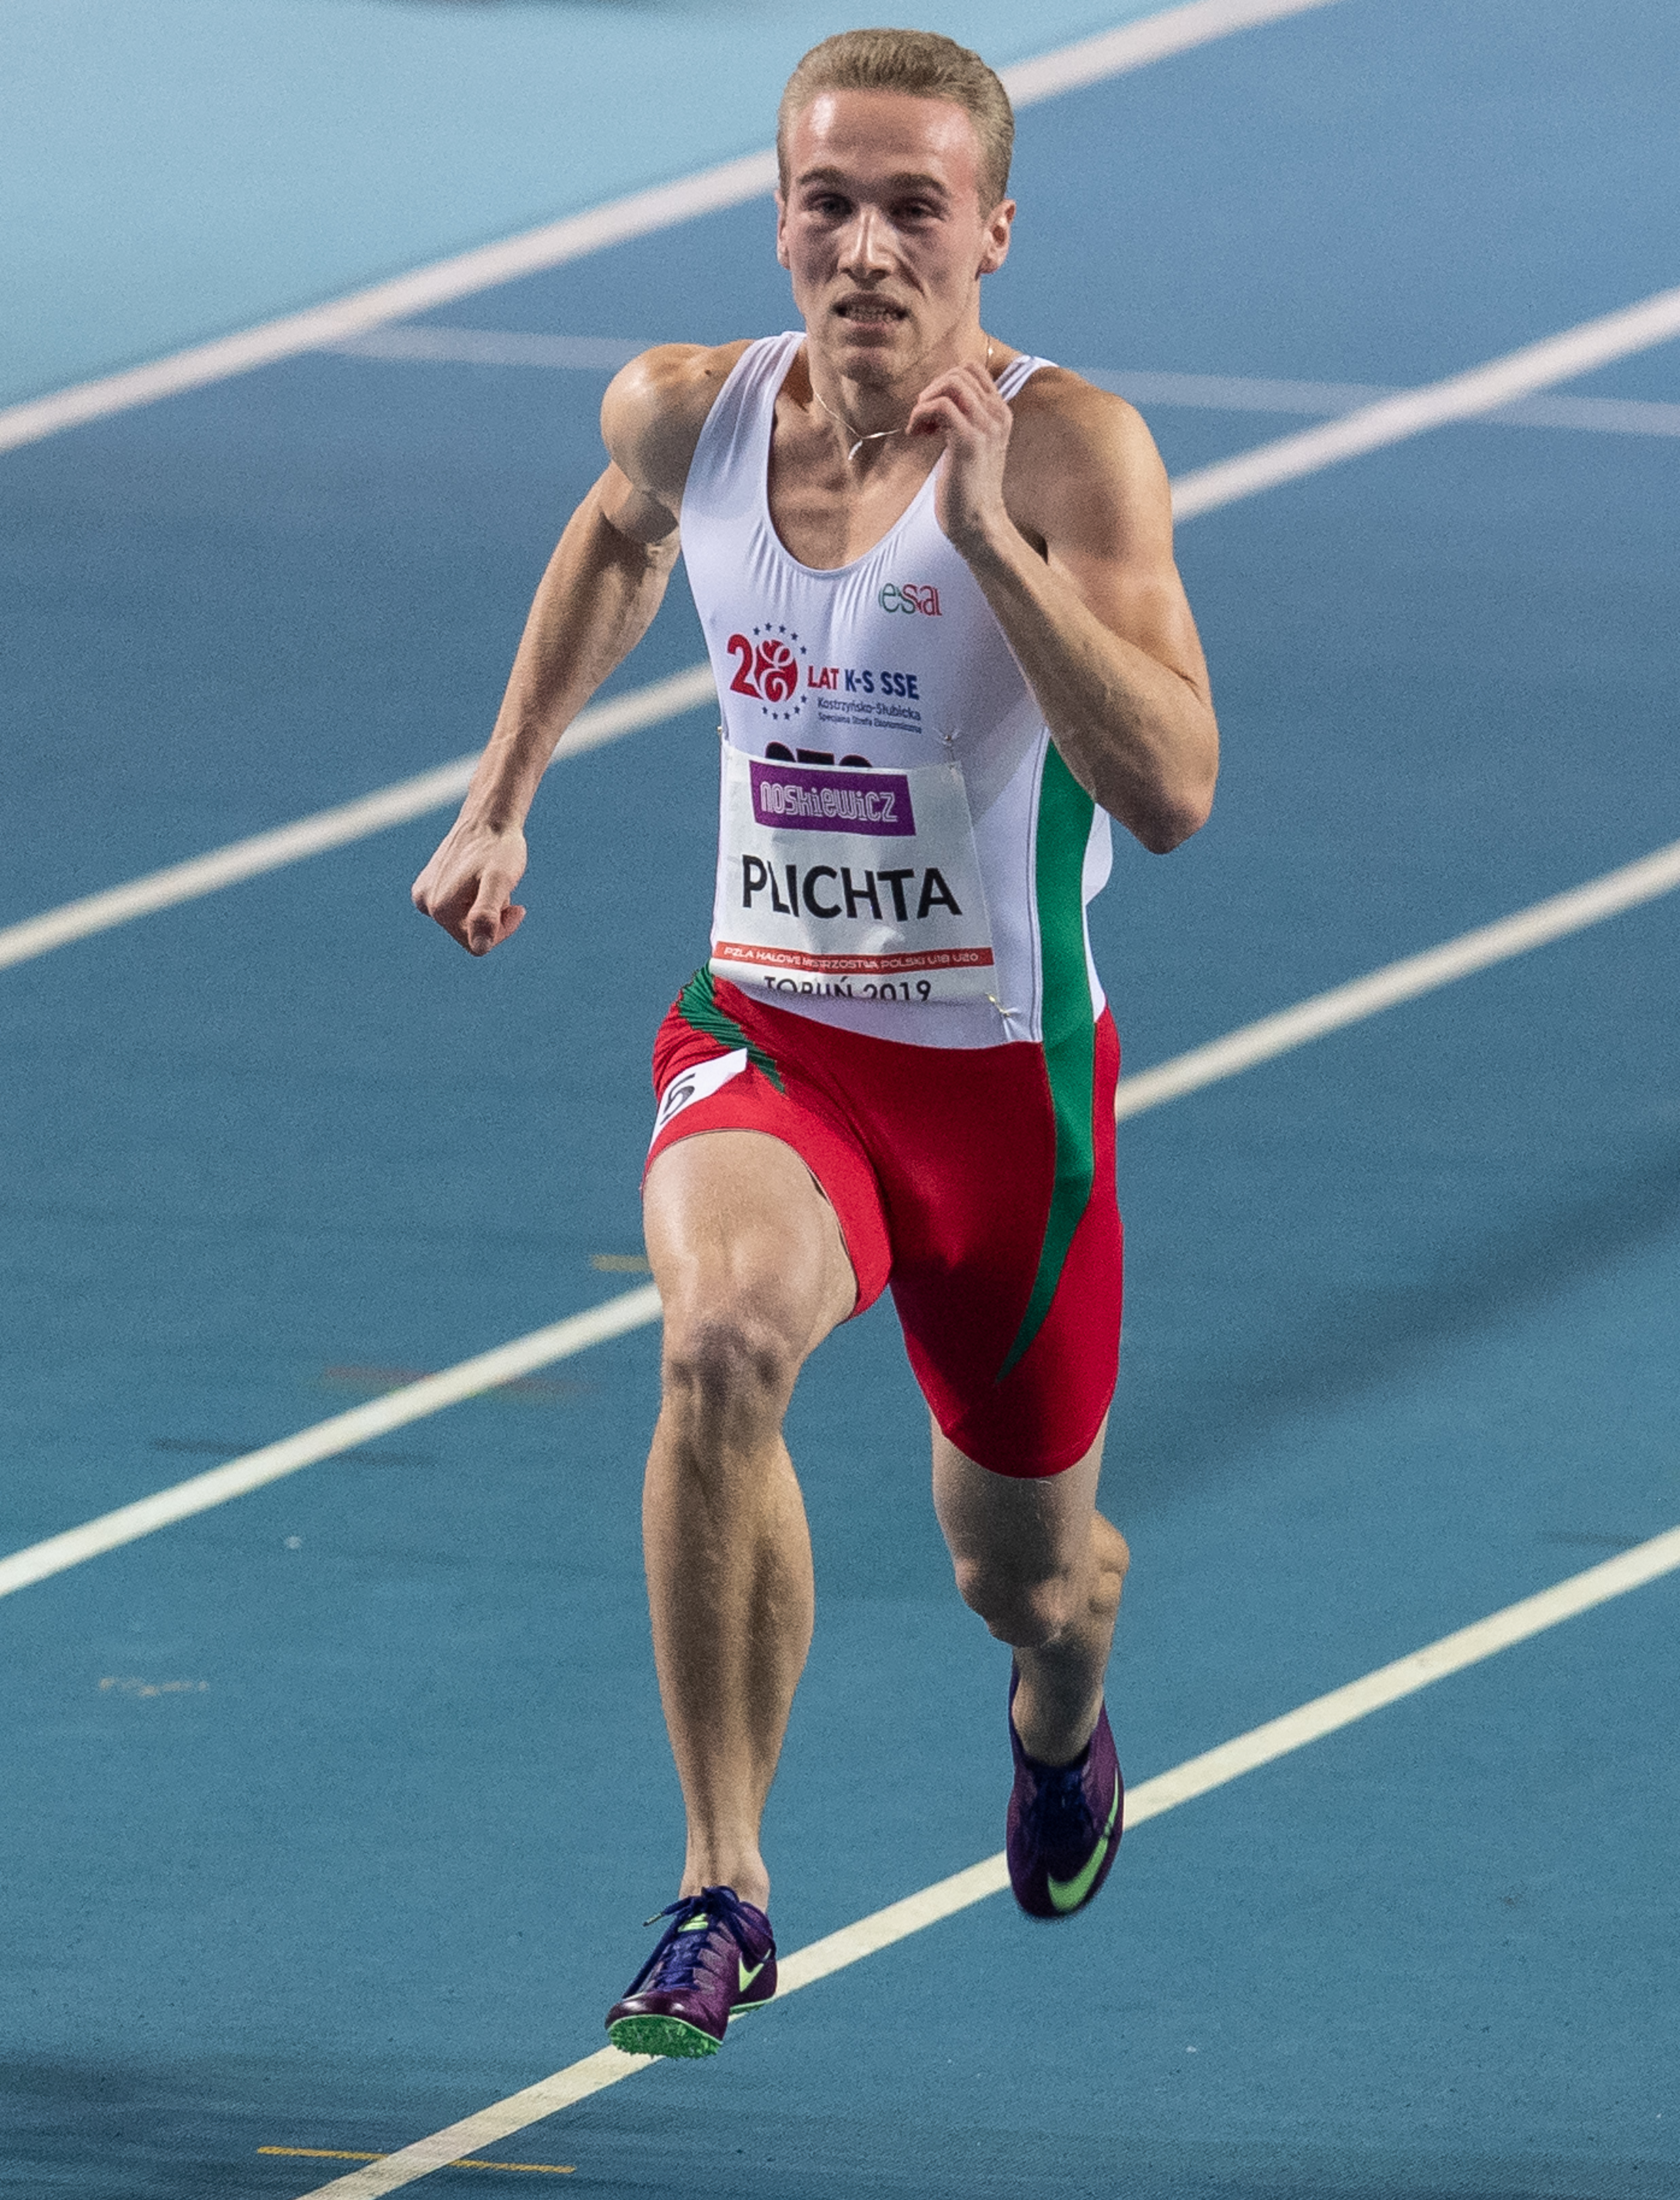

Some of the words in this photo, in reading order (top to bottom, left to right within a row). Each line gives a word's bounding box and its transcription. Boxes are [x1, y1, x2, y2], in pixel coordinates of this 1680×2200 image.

[807, 665, 840, 690] LAT
[844, 669, 875, 694] K-S
[880, 671, 920, 700] SSE
[759, 781, 898, 822] noskiewicz
[742, 853, 963, 922] PLICHTA
[723, 947, 755, 958] PZLA
[755, 951, 801, 966] HALOWE
[880, 957, 926, 968] POLSKI
[927, 953, 950, 965] U18
[953, 952, 979, 963] U20
[863, 979, 932, 1002] 2019
